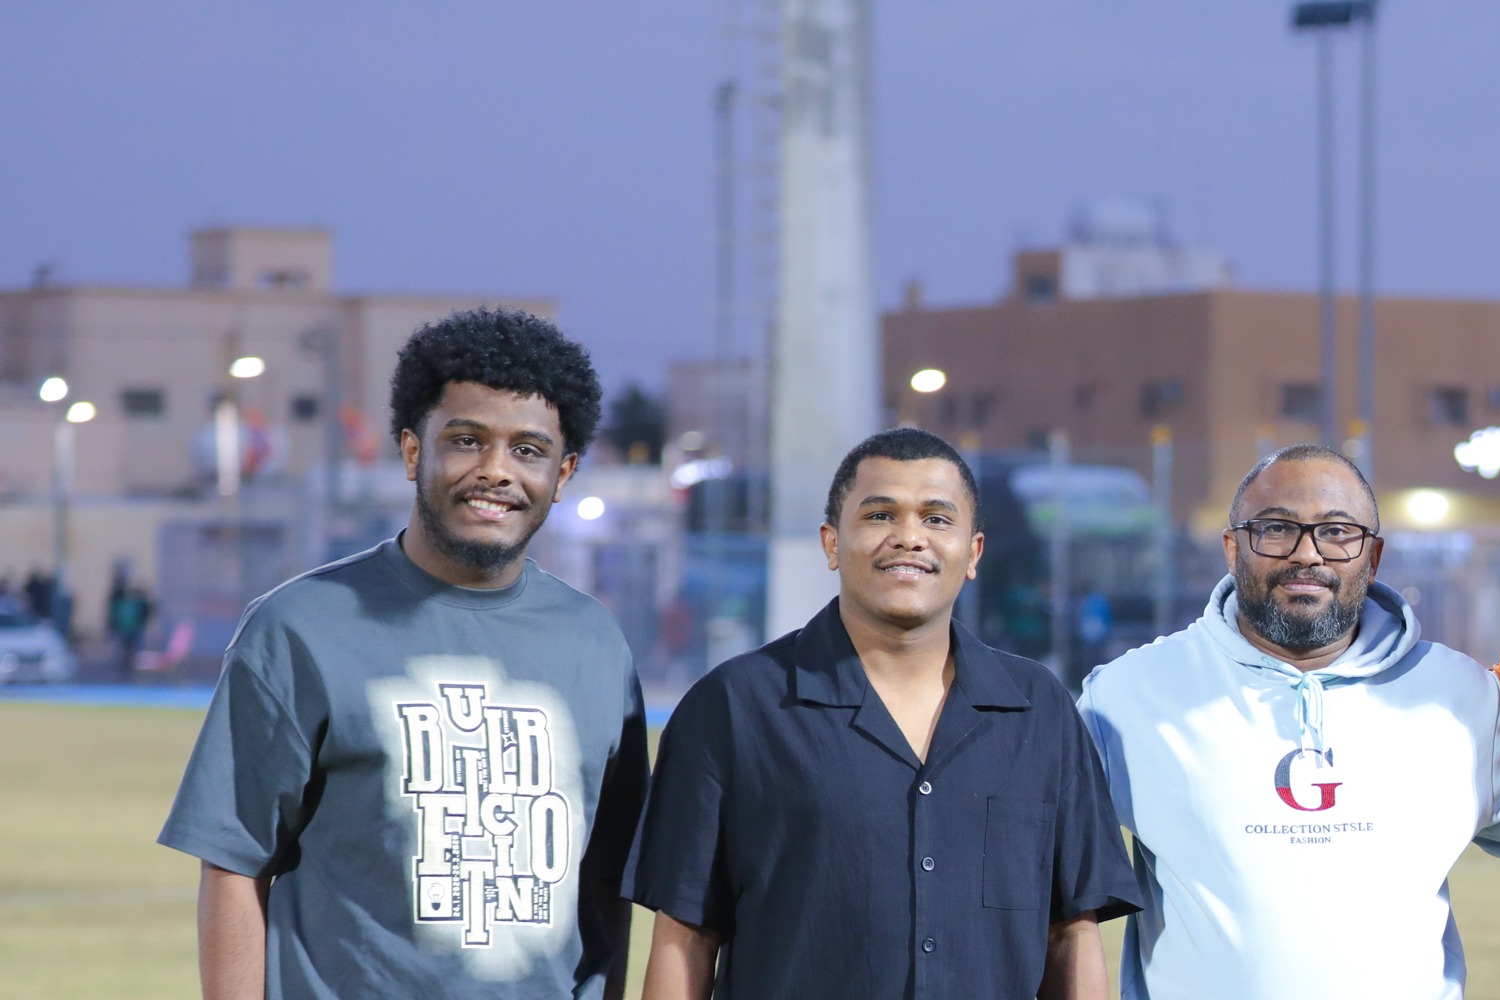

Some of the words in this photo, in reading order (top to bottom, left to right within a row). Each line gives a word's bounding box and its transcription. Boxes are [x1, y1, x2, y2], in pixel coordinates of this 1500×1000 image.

[1274, 747, 1343, 812] G
[1245, 824, 1331, 835] COLLECTION
[1290, 836, 1332, 844] FASHION
